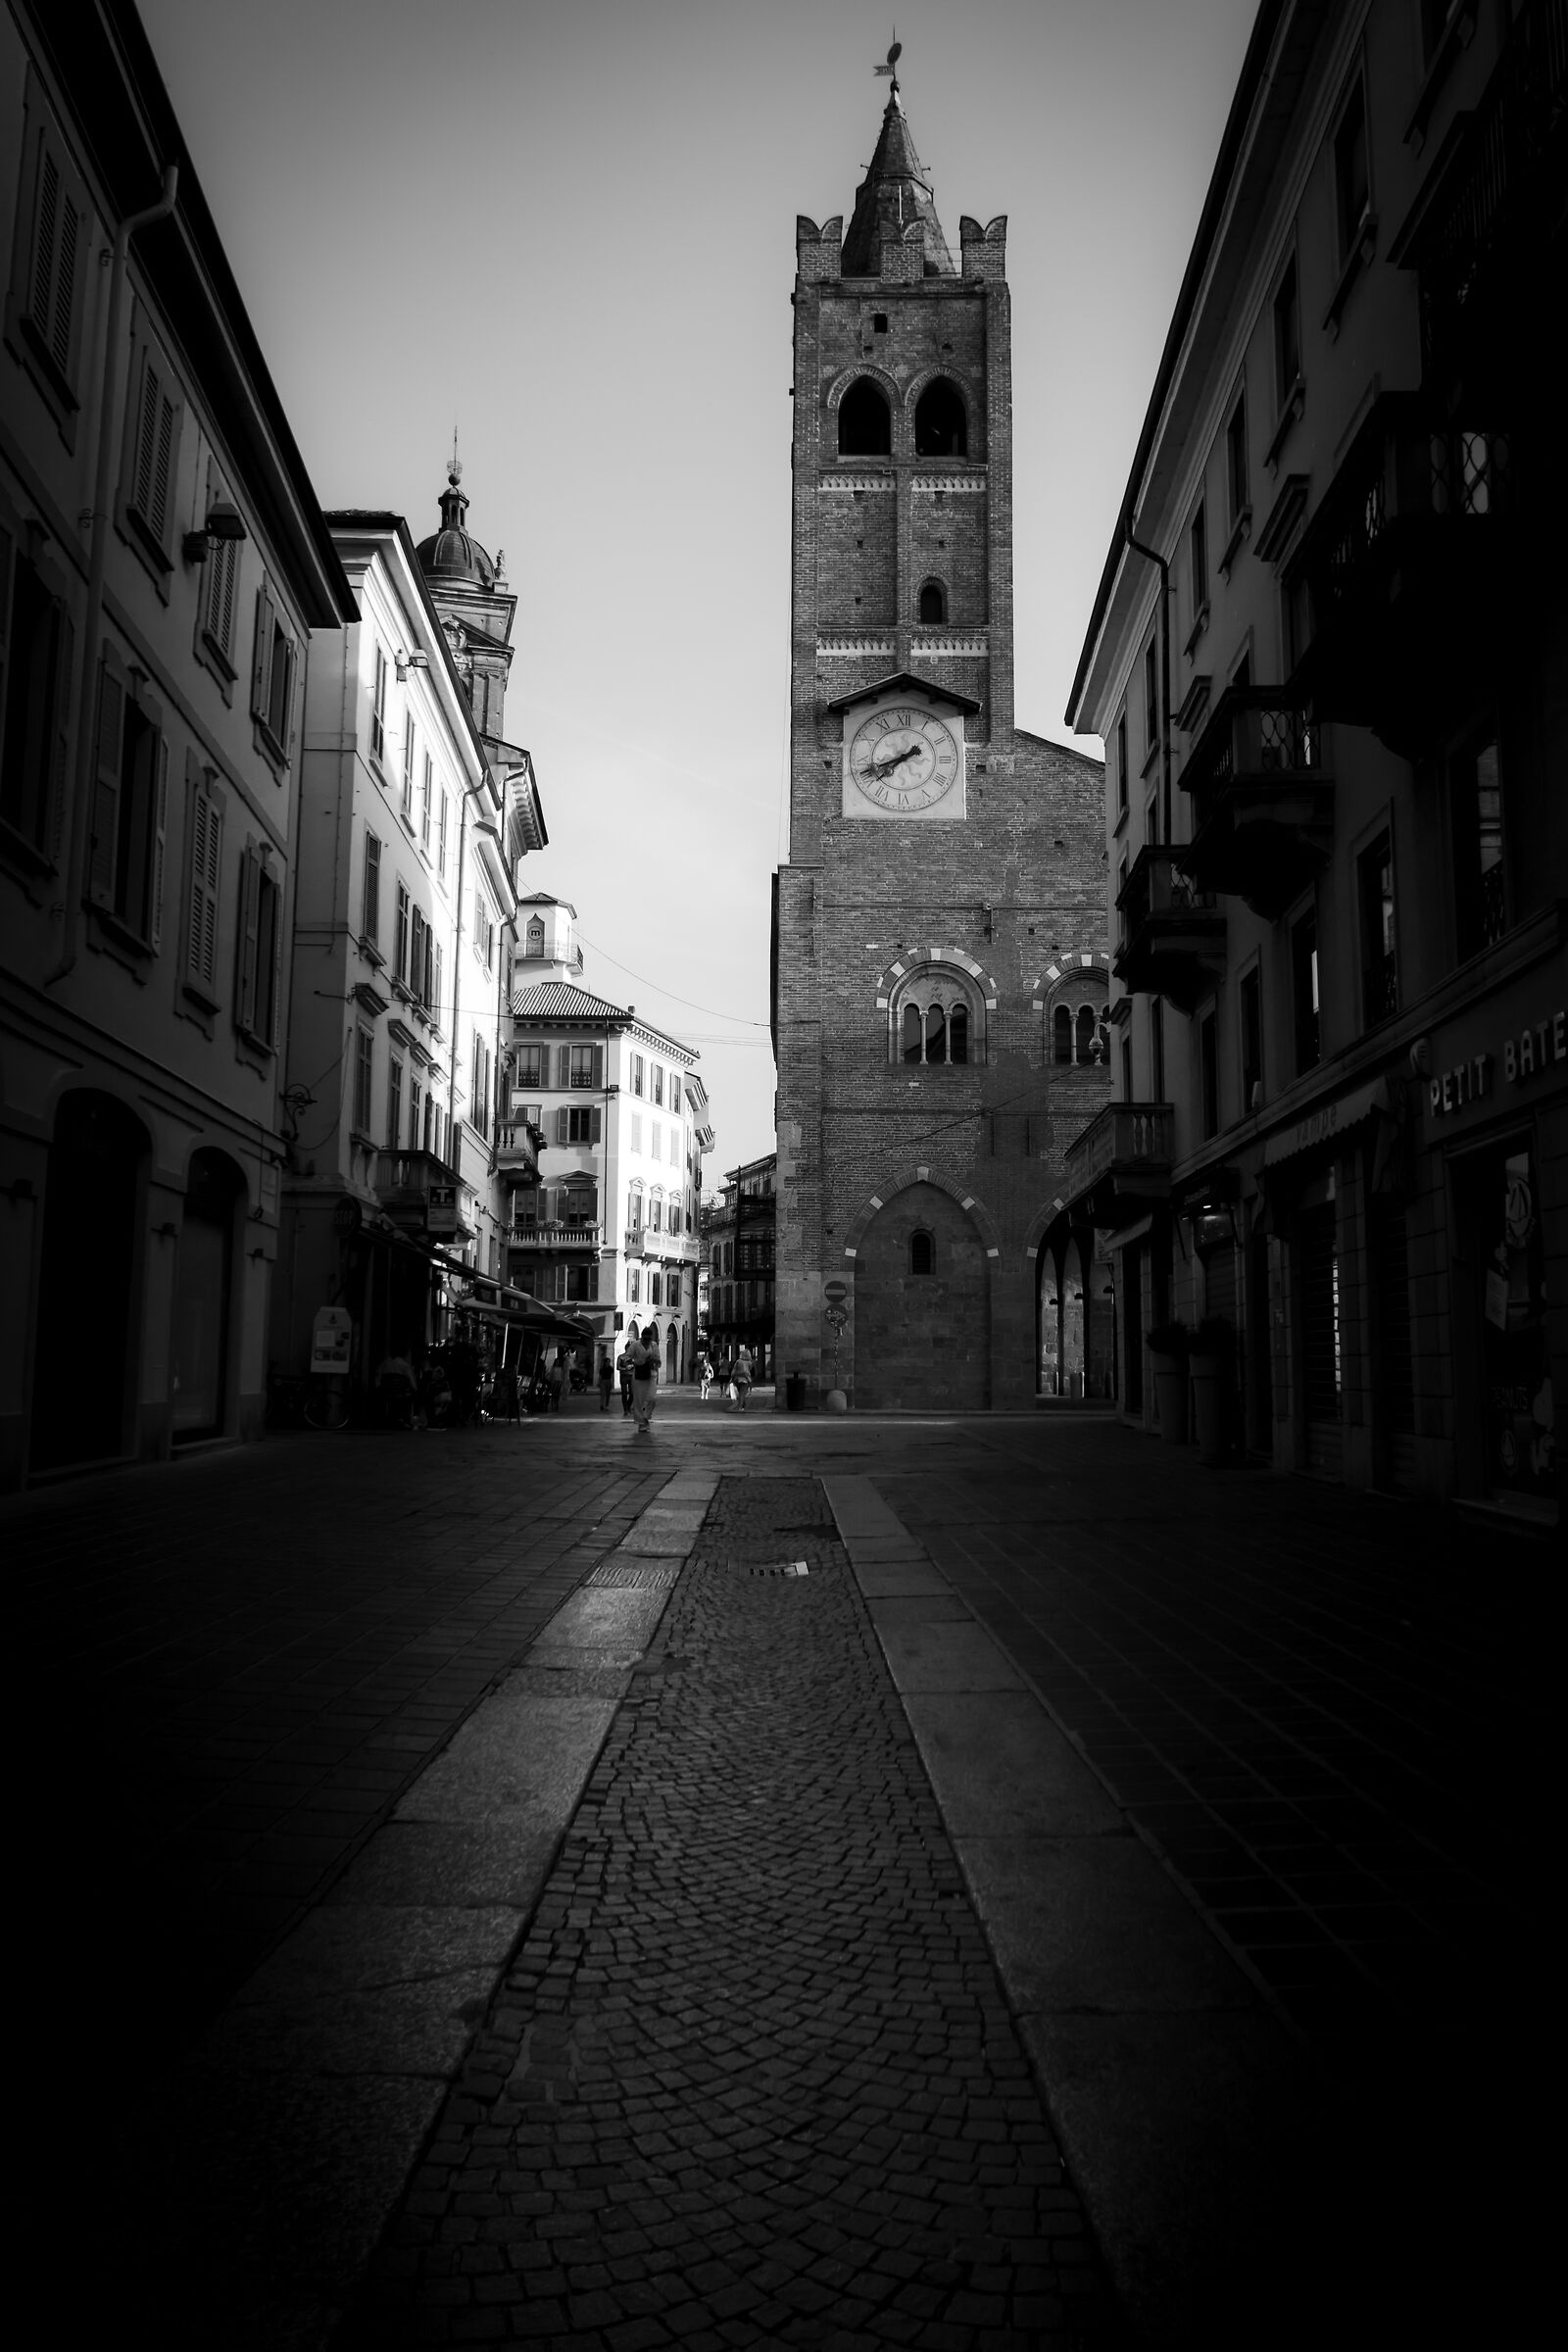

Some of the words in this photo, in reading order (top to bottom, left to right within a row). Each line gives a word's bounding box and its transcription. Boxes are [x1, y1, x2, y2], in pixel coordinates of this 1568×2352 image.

[875, 718, 890, 733] XI
[897, 714, 910, 726] XII
[921, 720, 928, 731] I
[861, 733, 875, 746] X
[934, 736, 946, 746] II
[939, 756, 952, 764] III
[932, 772, 948, 786] IIII
[875, 786, 889, 802] VII
[898, 793, 909, 805] VI
[921, 790, 931, 802] V
[1429, 1054, 1487, 1118] PETIT
[1504, 1010, 1567, 1084] BATE
[335, 1209, 354, 1225] STOP
